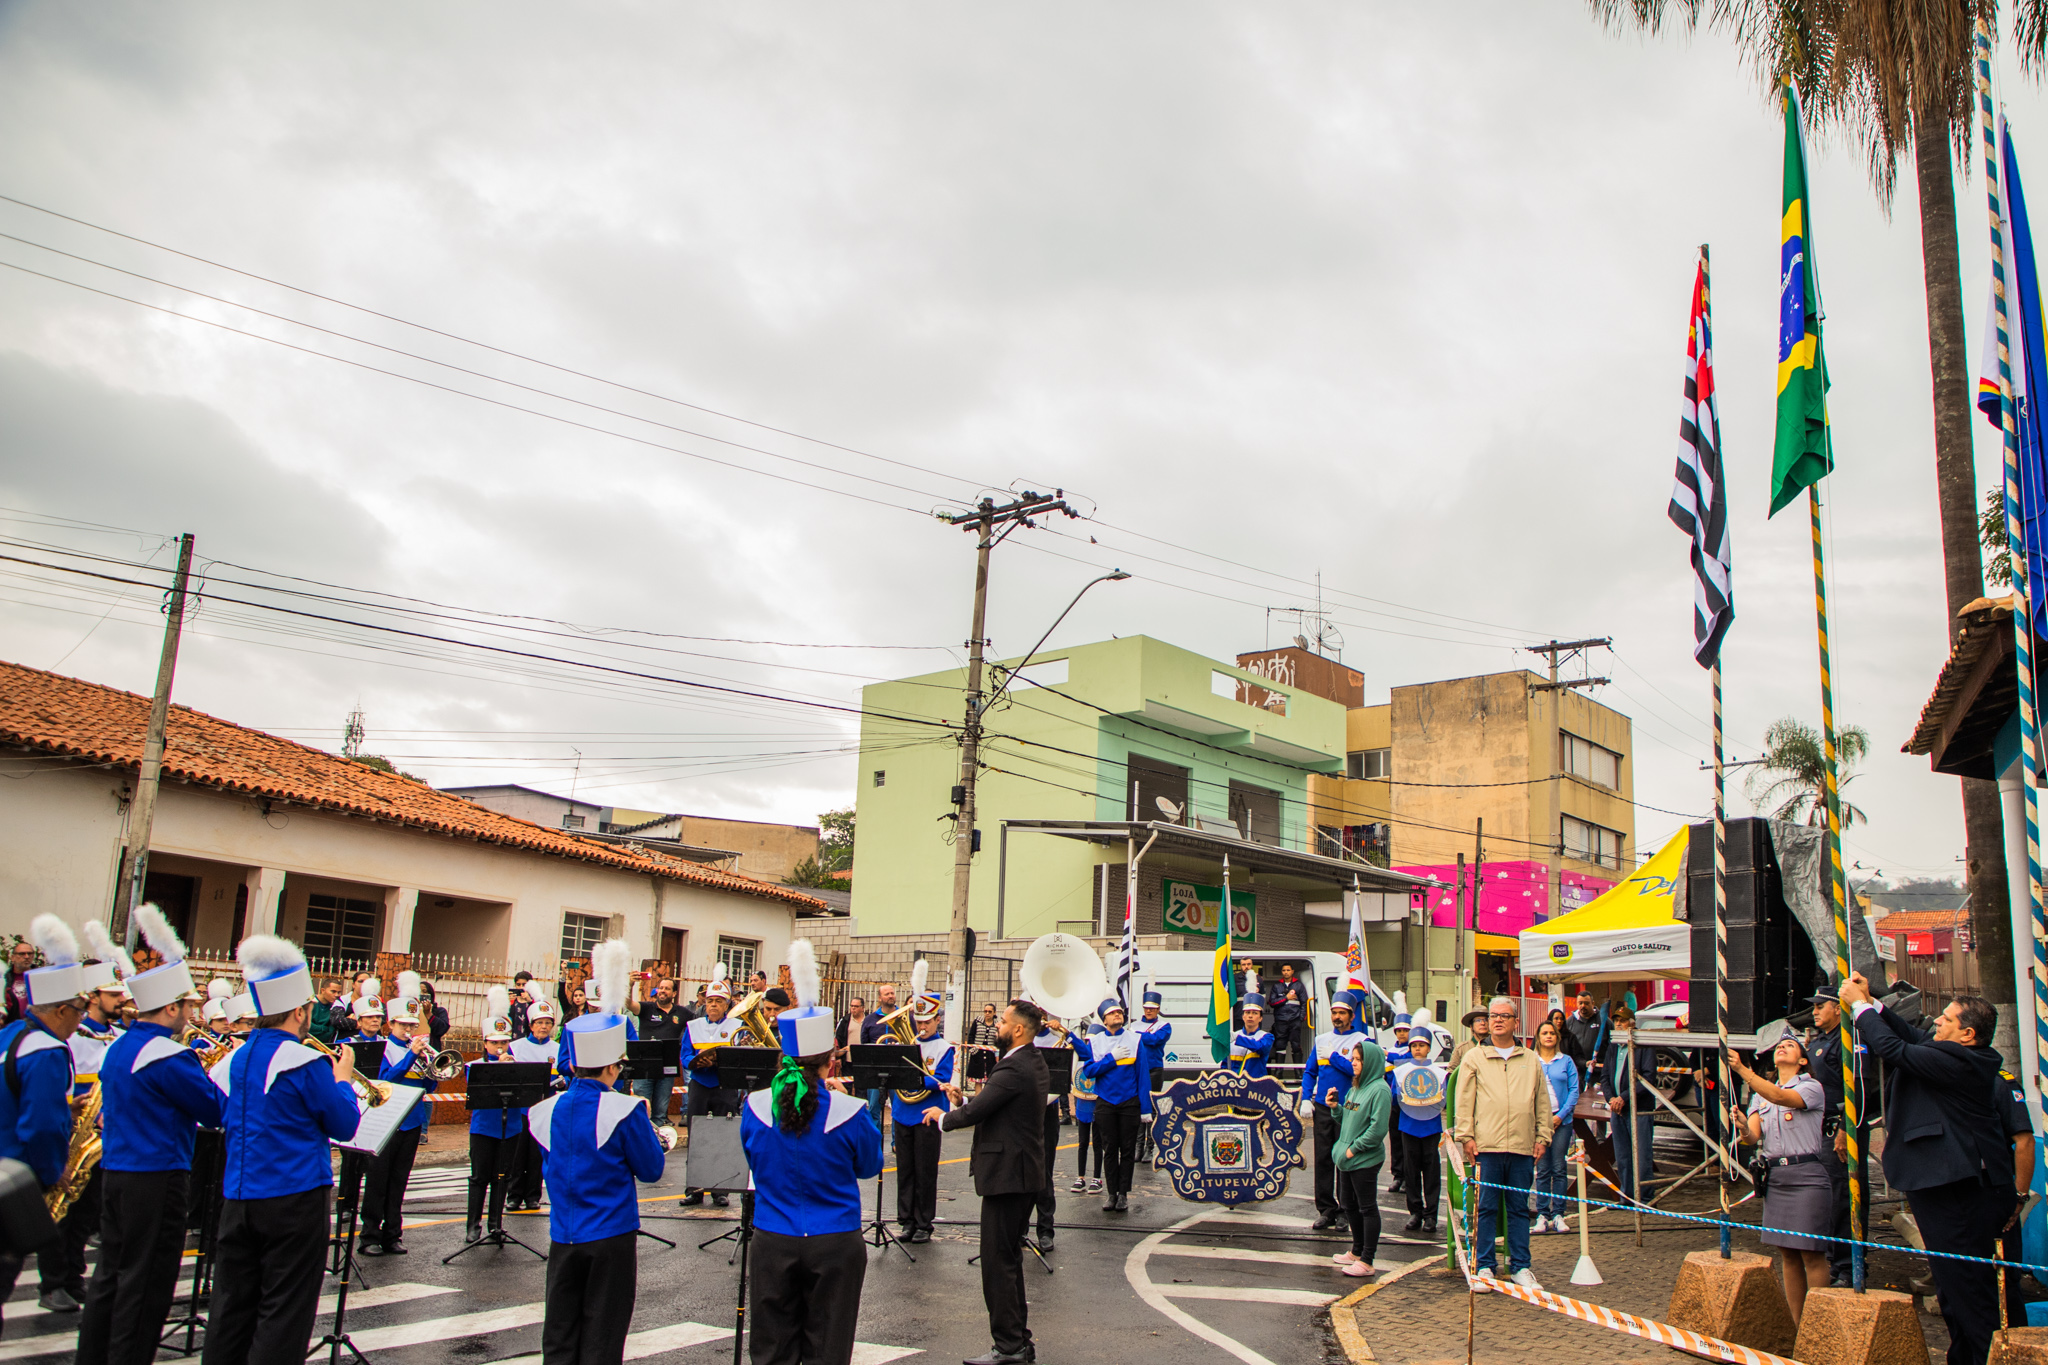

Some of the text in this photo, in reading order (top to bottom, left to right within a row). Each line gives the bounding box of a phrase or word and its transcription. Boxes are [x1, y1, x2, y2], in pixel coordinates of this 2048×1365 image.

[1173, 888, 1194, 899] LOJA
[1169, 899, 1250, 933] ZONO
[1612, 943, 1637, 953] GUSTO
[1643, 943, 1672, 952] SALUTE
[1162, 1088, 1295, 1146] BANDA MARCIAL MUNICIPAL
[1201, 1178, 1258, 1188] ITUPEVA
[1223, 1190, 1238, 1199] SP
[1612, 1316, 1643, 1330] DEMUTRAN
[1700, 1340, 1734, 1355] DEMUTRAN
